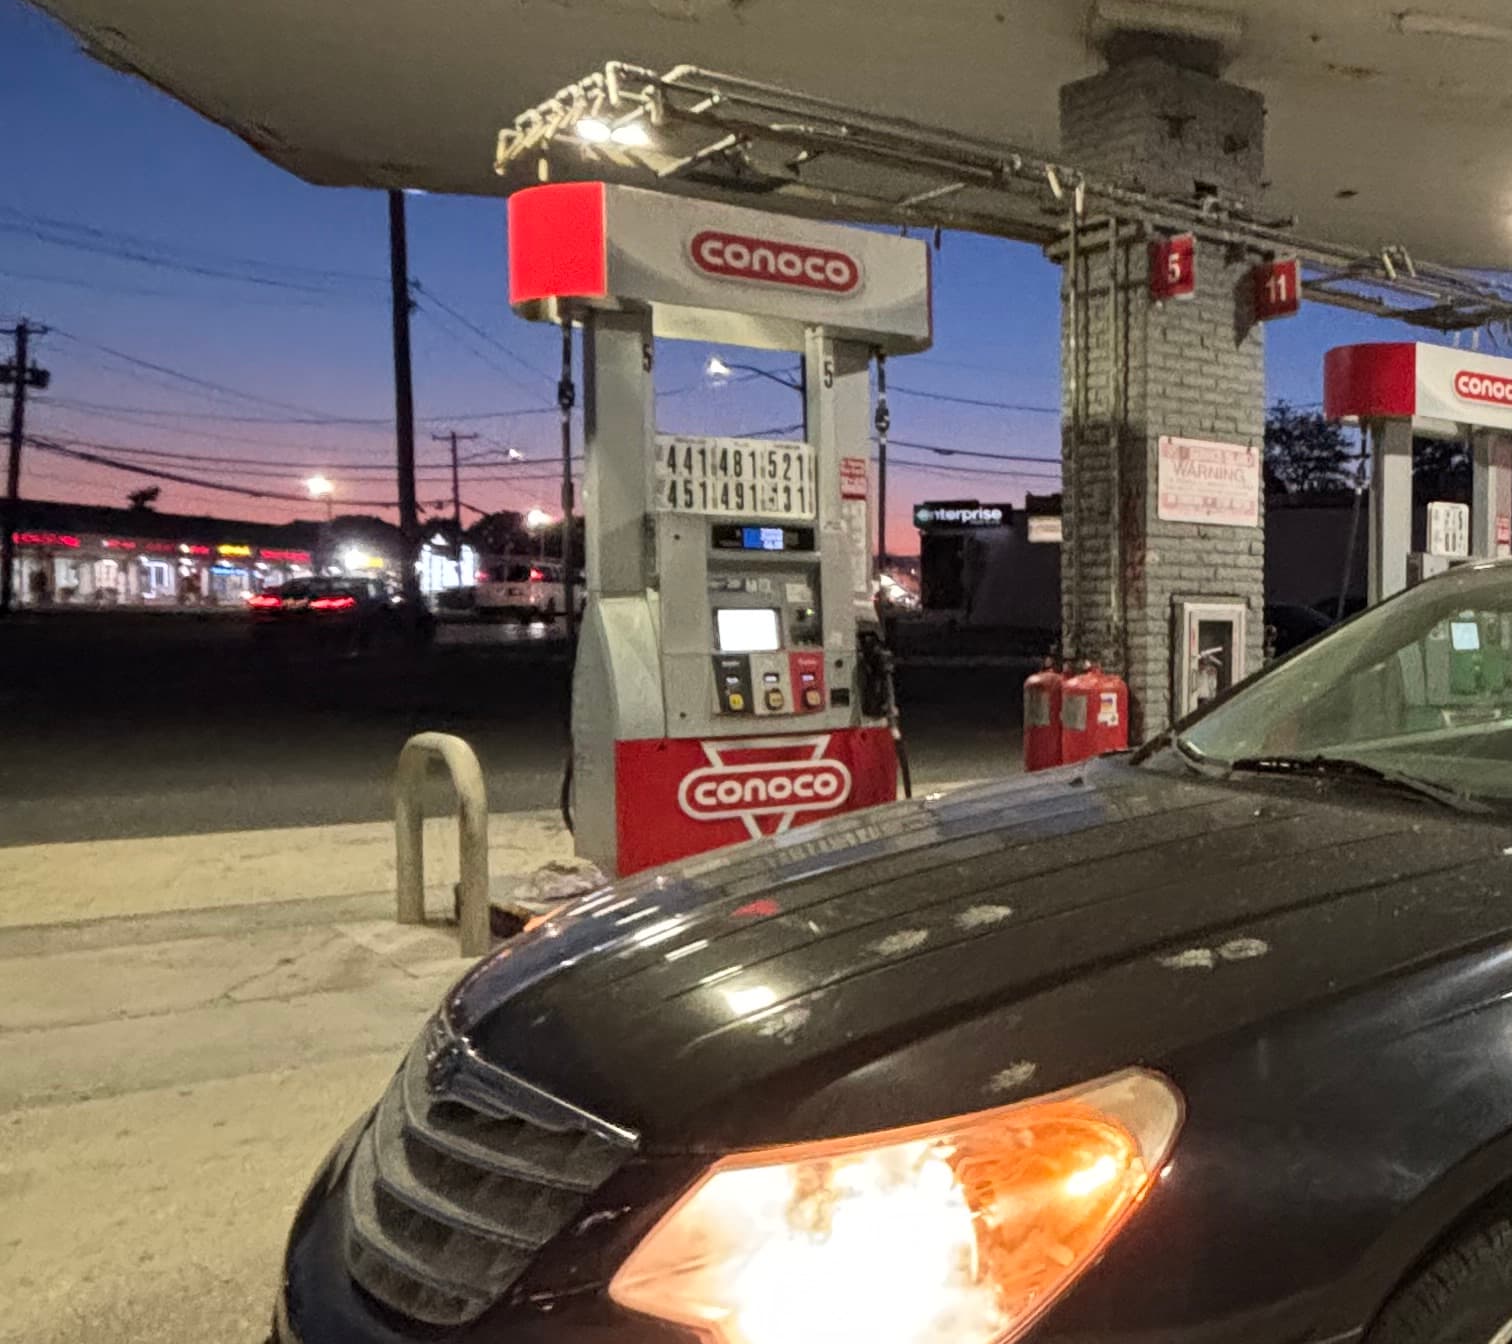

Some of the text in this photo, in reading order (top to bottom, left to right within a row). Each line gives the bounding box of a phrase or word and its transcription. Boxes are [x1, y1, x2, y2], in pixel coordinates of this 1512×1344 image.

[1167, 253, 1181, 283] 5
[1265, 273, 1287, 304] 11
[823, 361, 833, 389] 5
[1173, 459, 1246, 483] WARNING
